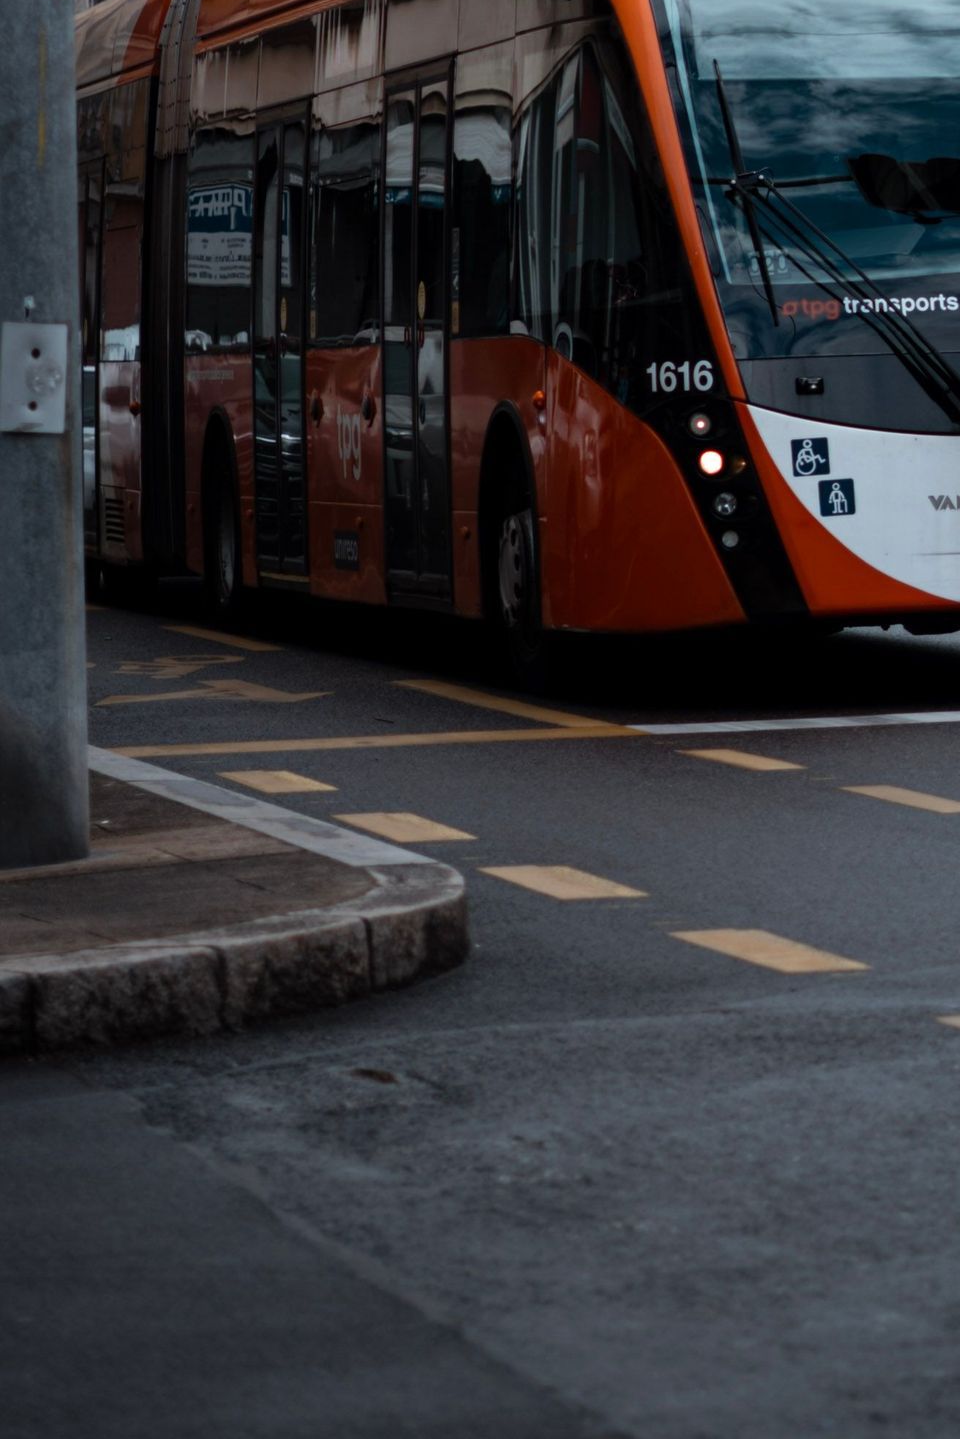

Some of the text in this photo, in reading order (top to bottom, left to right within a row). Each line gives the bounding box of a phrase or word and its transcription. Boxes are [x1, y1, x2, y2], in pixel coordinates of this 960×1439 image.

[844, 293, 959, 315] transports
[646, 360, 713, 392] 1616
[336, 404, 361, 480] tpg
